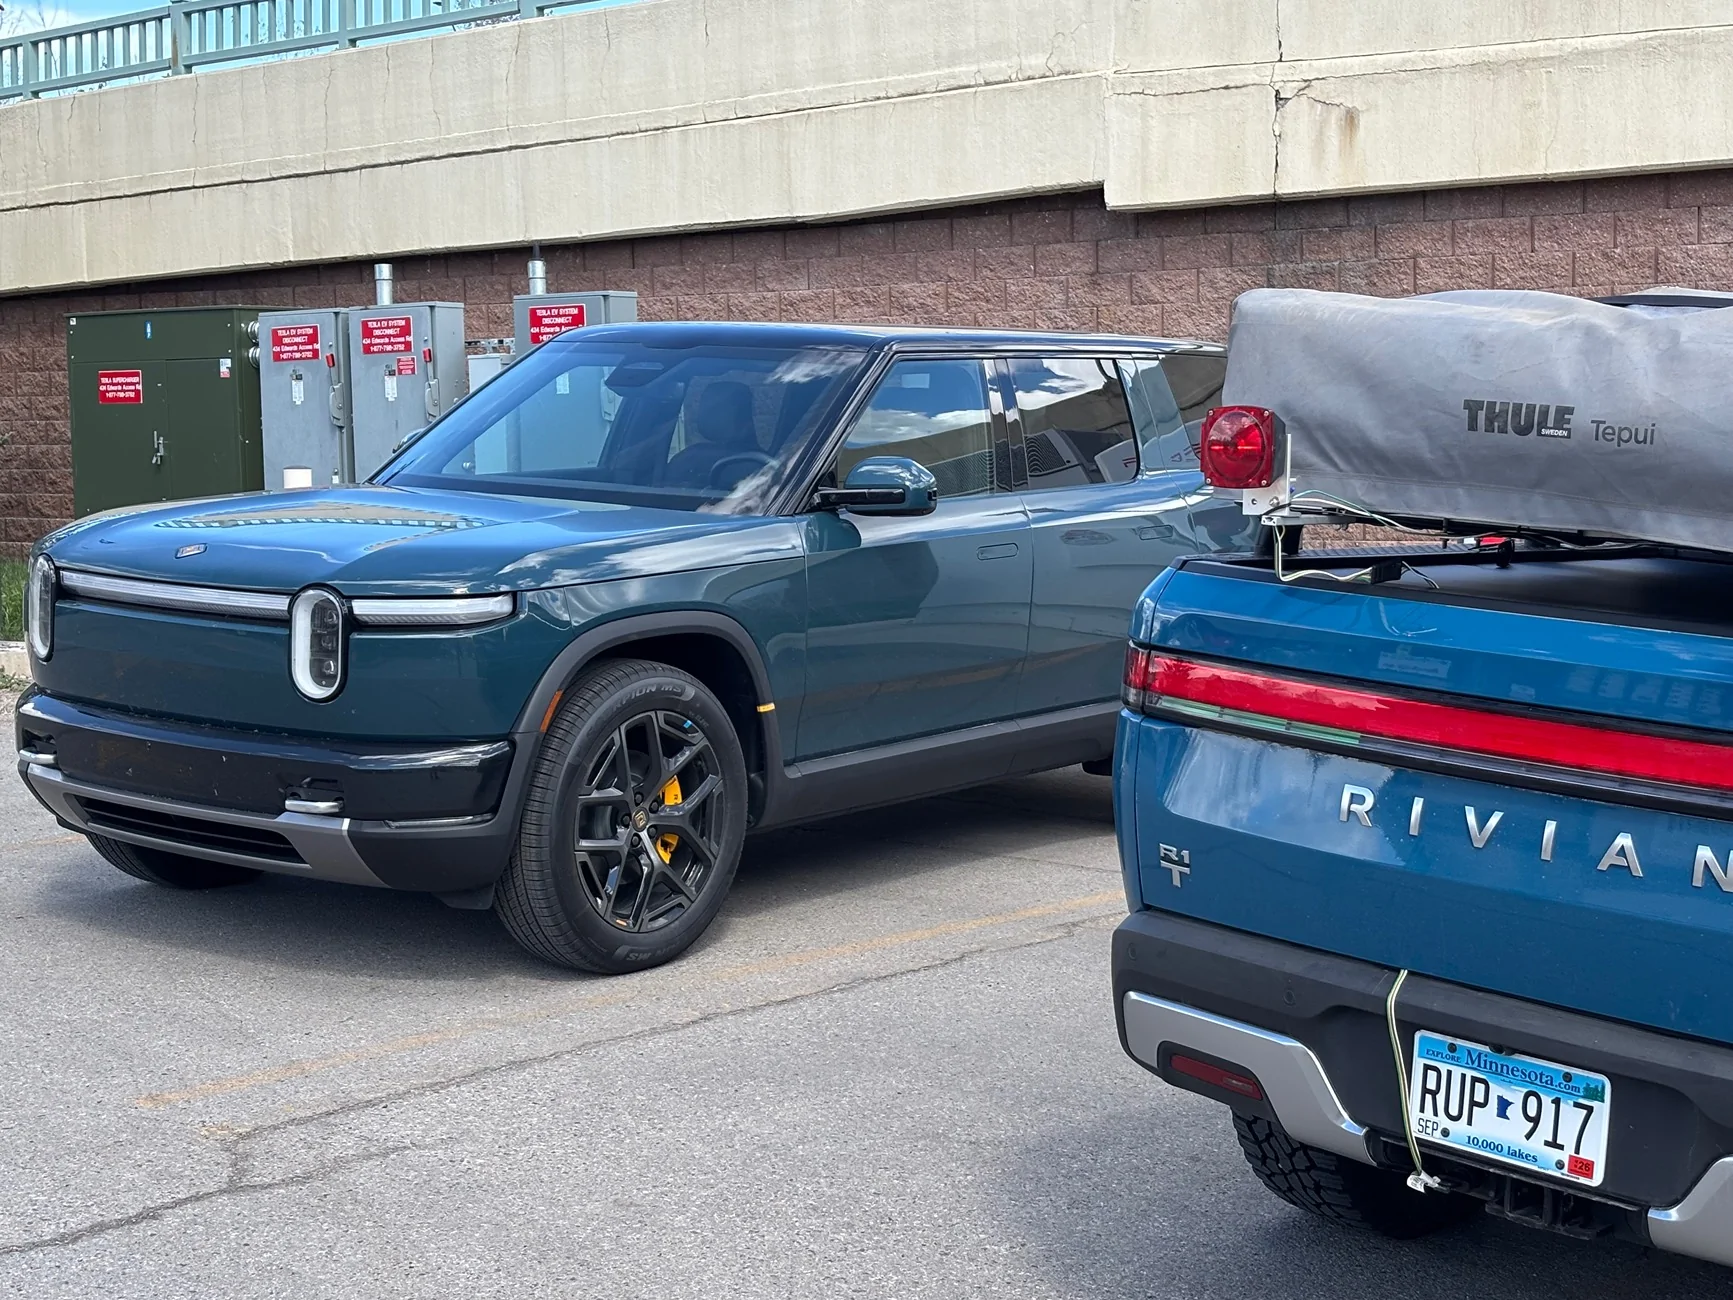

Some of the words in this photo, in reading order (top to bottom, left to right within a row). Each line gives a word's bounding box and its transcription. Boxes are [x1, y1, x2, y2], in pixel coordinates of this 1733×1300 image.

[551, 308, 558, 316] EV
[559, 307, 579, 315] SYSTEM
[381, 320, 388, 328] EV
[388, 319, 406, 327] SYSTEM
[542, 316, 573, 325] DISCONNECT
[290, 328, 296, 336] EV
[296, 327, 314, 335] SYSTEM
[372, 328, 400, 336] DISCONNECT
[282, 335, 308, 344] DISCONNECT
[1463, 399, 1575, 437] THULE
[1590, 419, 1656, 447] Tepui
[1541, 428, 1569, 437] SWEDEN
[1339, 783, 1733, 892] RIVIAN
[1426, 1048, 1461, 1063] EXPLORE
[1465, 1049, 1581, 1093] Minnesota.com
[1419, 1063, 1490, 1126] RUP
[1522, 1090, 1594, 1155] 917
[1417, 1118, 1439, 1137] SEP
[1507, 1145, 1538, 1163] lakes
